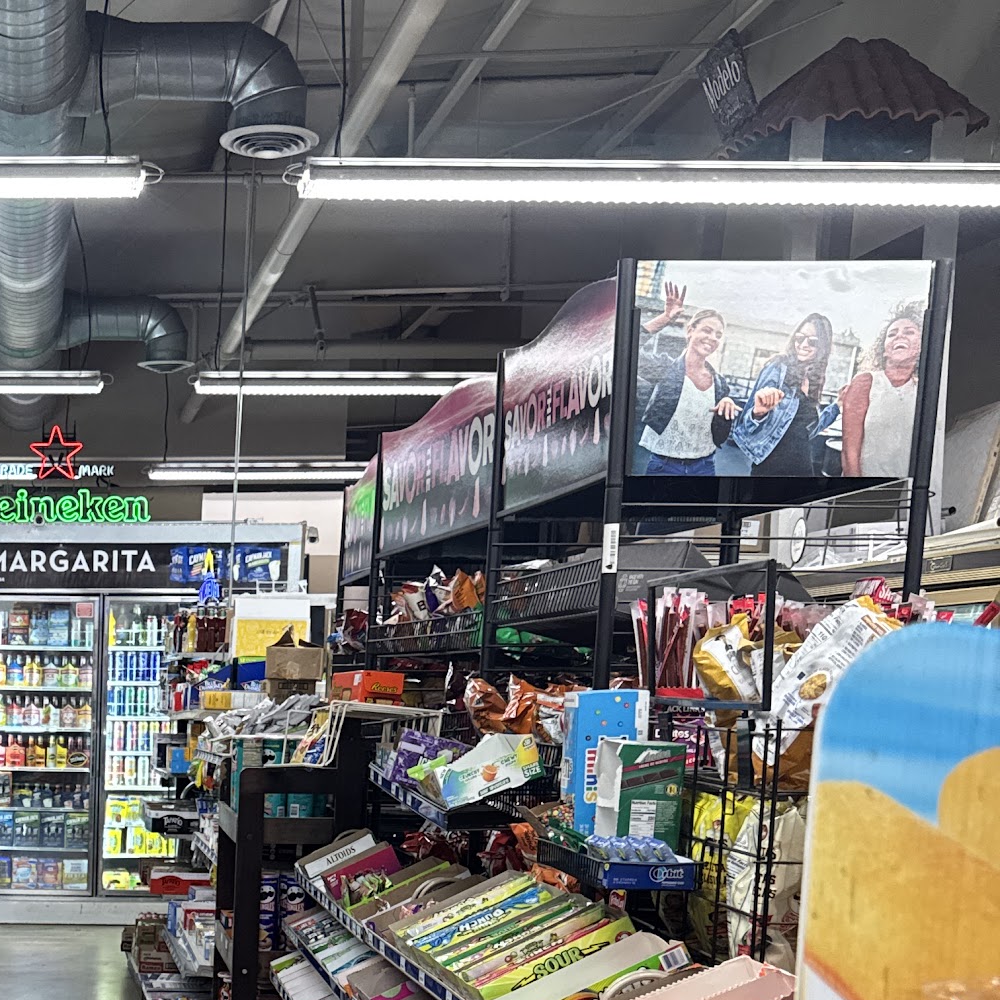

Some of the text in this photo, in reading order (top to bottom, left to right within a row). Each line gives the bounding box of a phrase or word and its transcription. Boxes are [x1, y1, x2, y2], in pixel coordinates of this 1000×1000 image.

[702, 57, 741, 114] Modelo
[505, 391, 547, 452] SAVOR
[551, 354, 614, 423] FLAVOR
[78, 465, 115, 478] MARK
[383, 449, 426, 512] SAVOR
[430, 413, 496, 488] FLAVOR
[524, 767, 543, 779] SIZE
[325, 845, 356, 867] ALTOIDS
[649, 866, 684, 883] Orbit
[533, 946, 585, 979] SOUR
